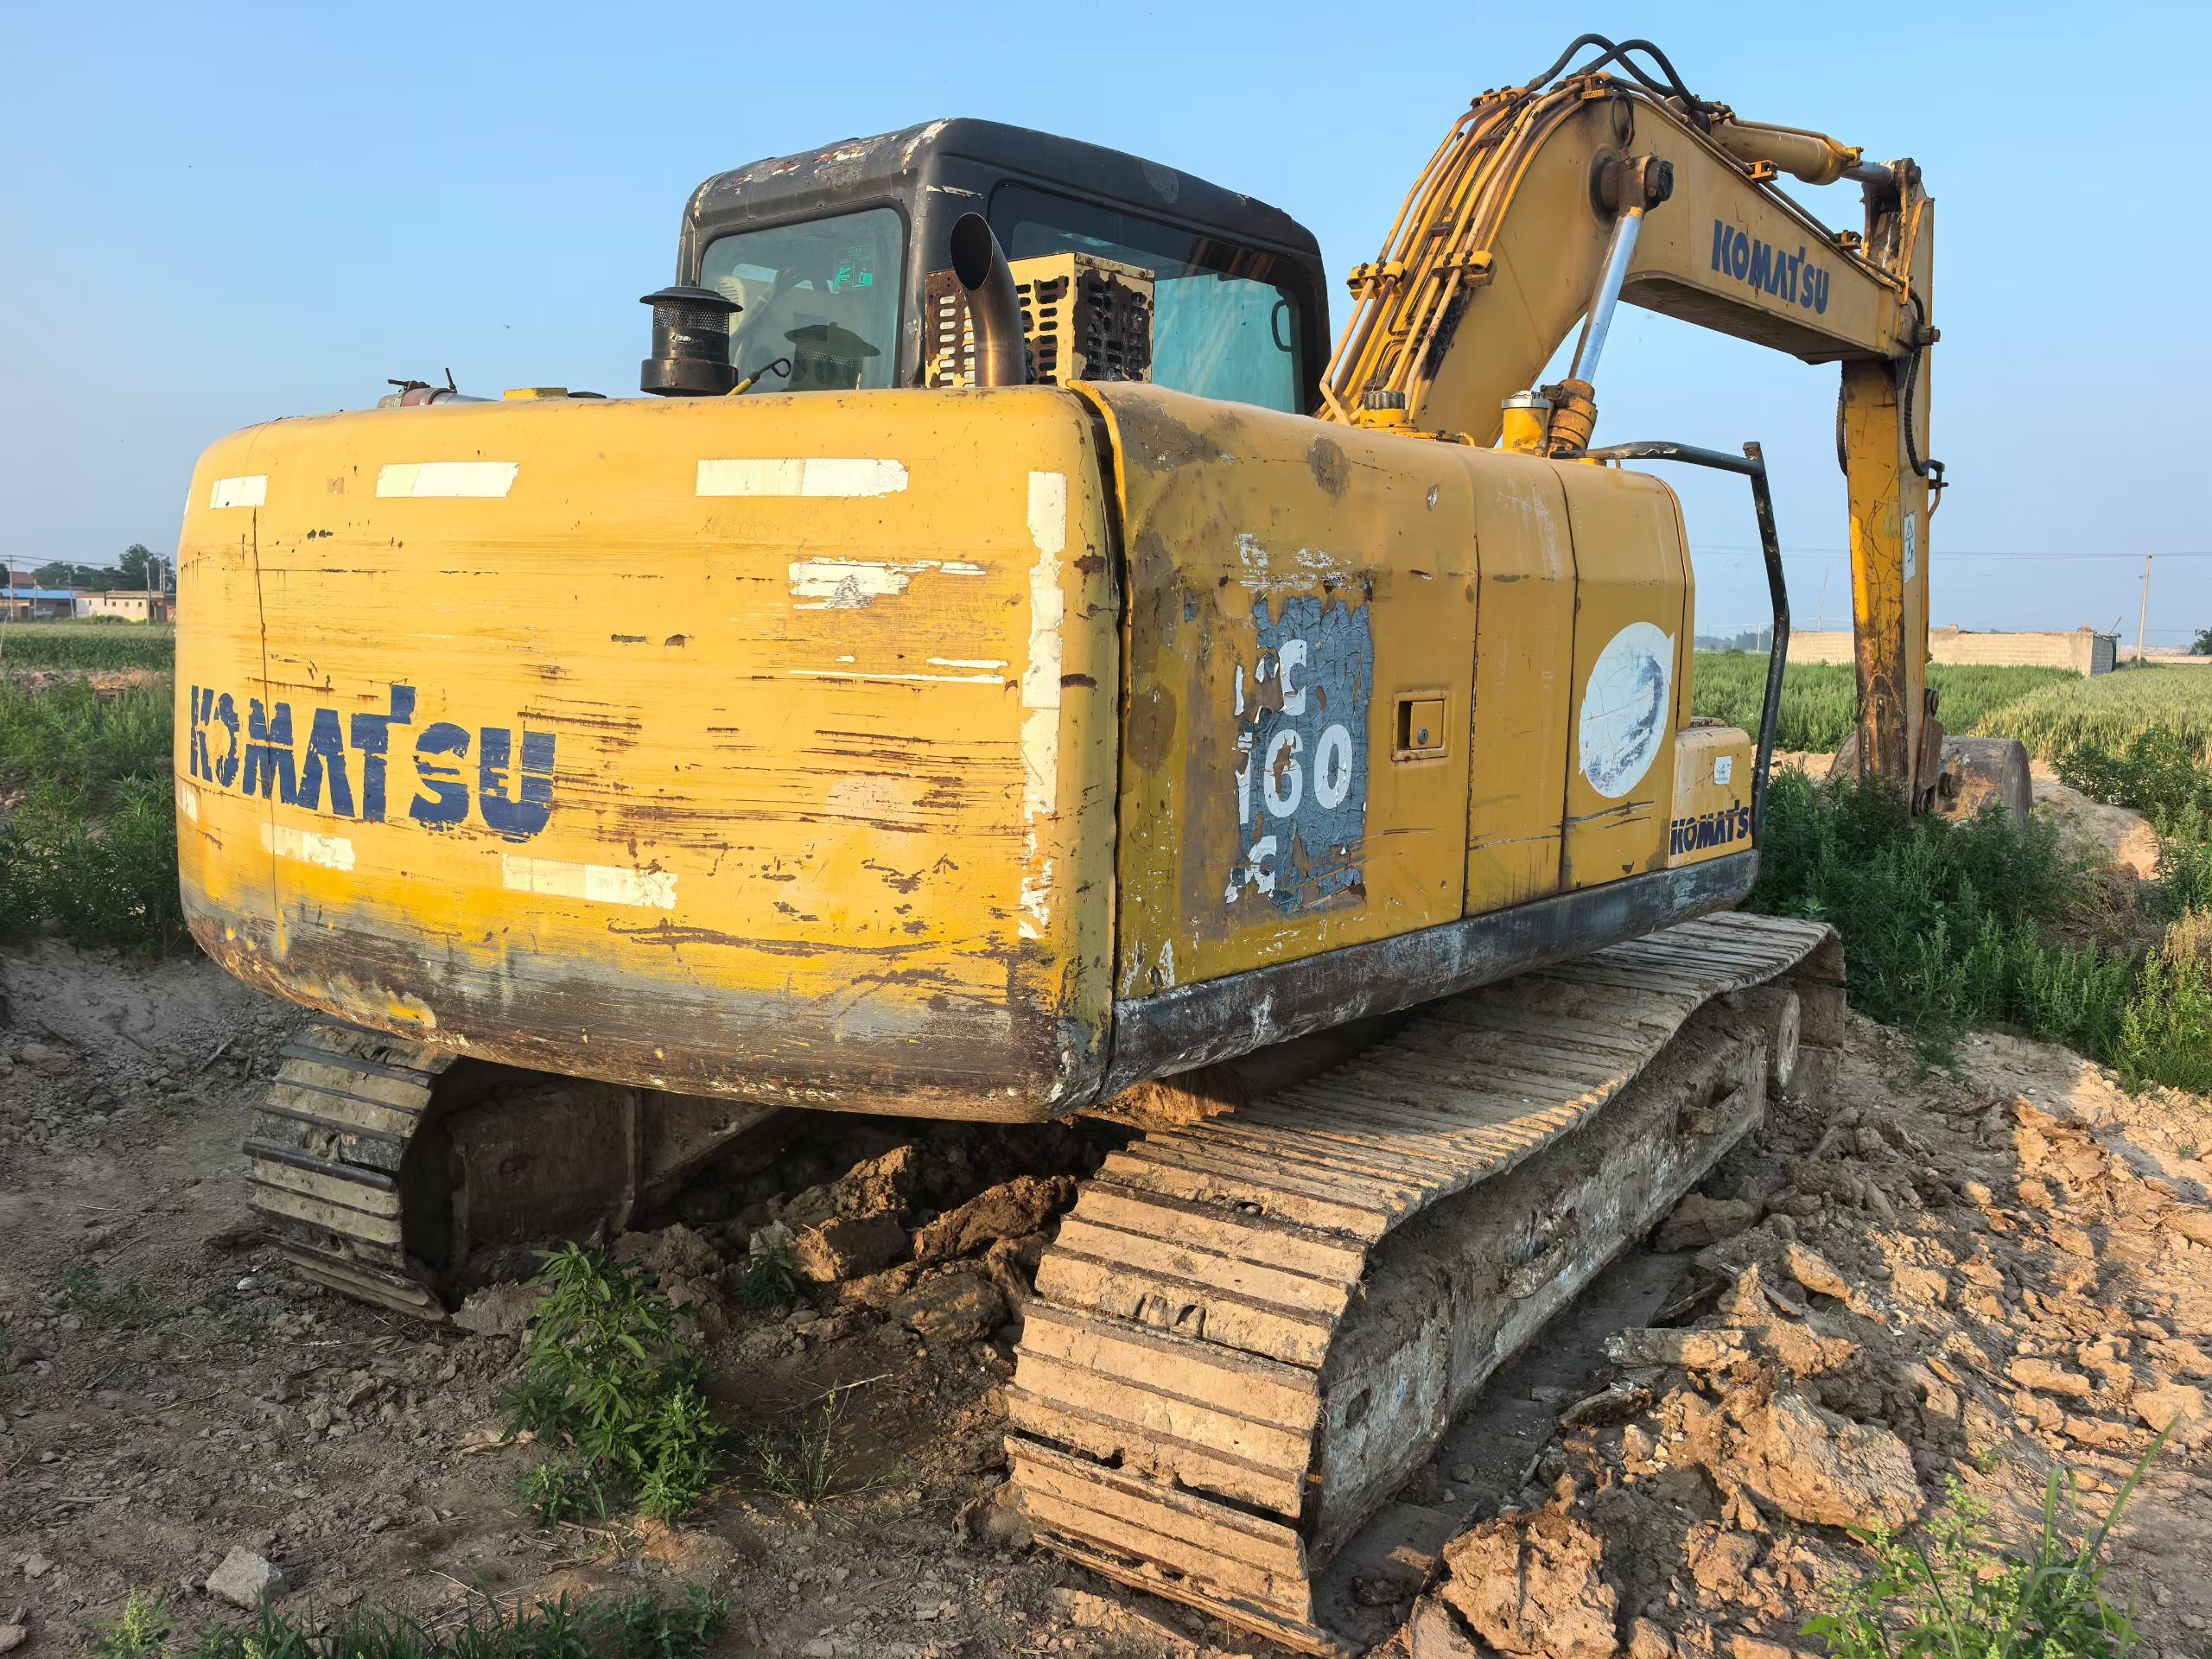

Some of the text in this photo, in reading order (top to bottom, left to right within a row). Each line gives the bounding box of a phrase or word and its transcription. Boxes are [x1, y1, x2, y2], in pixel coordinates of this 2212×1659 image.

[1712, 219, 1830, 315] KOMATSU
[190, 684, 556, 843] KOMATSU
[1670, 799, 1752, 856] KOMATS
